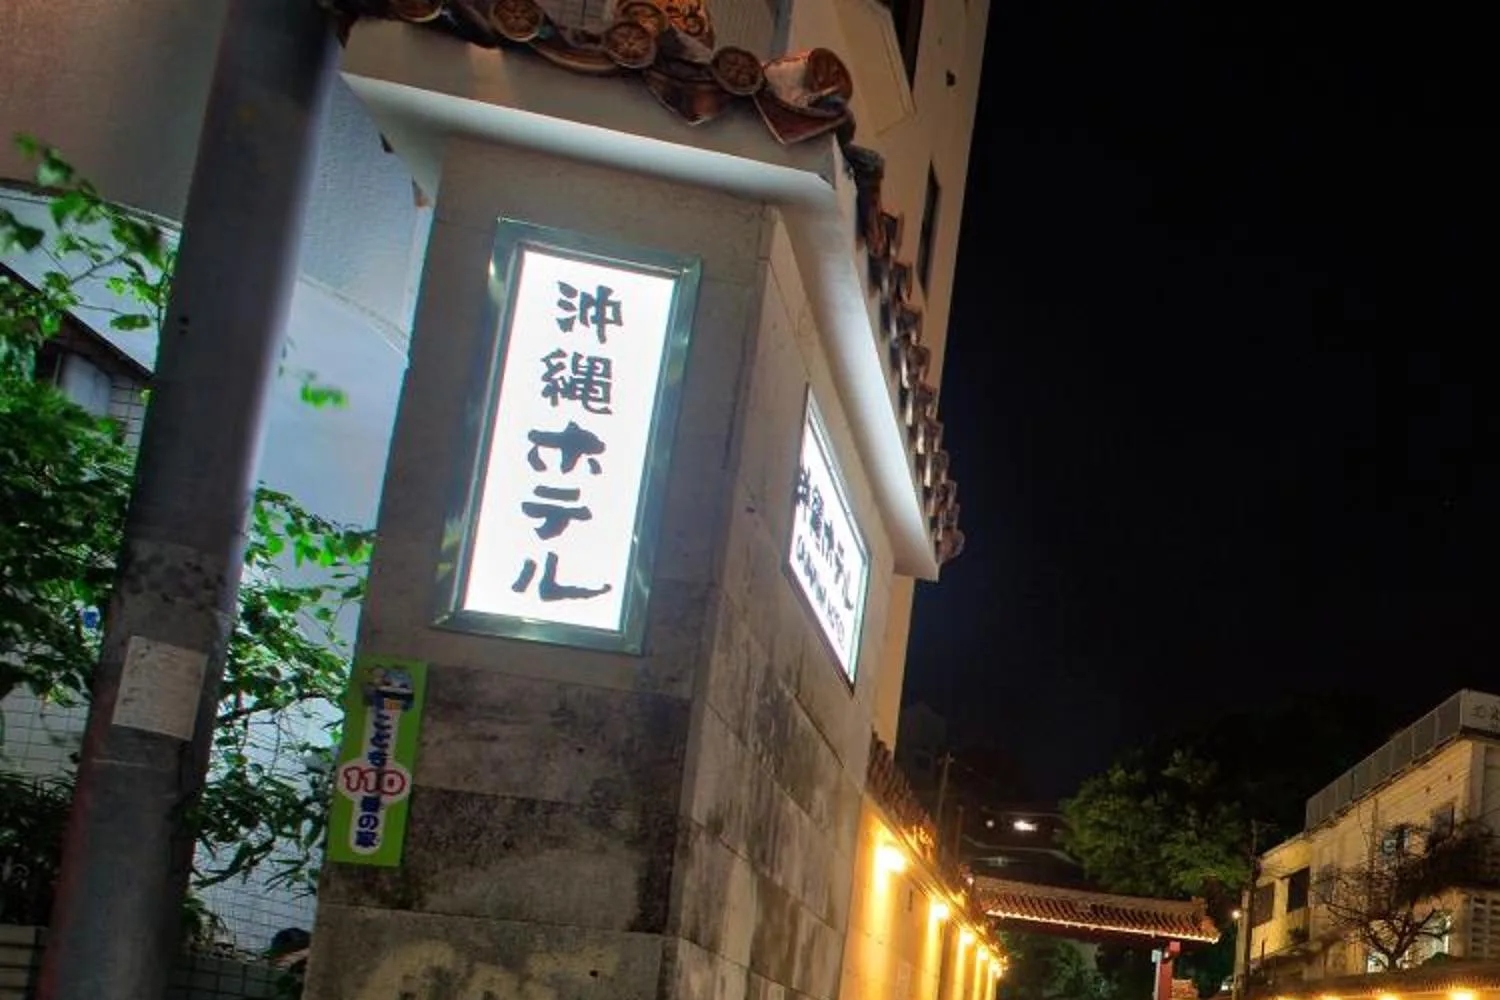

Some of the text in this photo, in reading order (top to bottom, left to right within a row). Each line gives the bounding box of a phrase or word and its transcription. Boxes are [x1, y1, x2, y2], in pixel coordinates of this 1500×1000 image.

[511, 280, 624, 602] 沖縄ホテル
